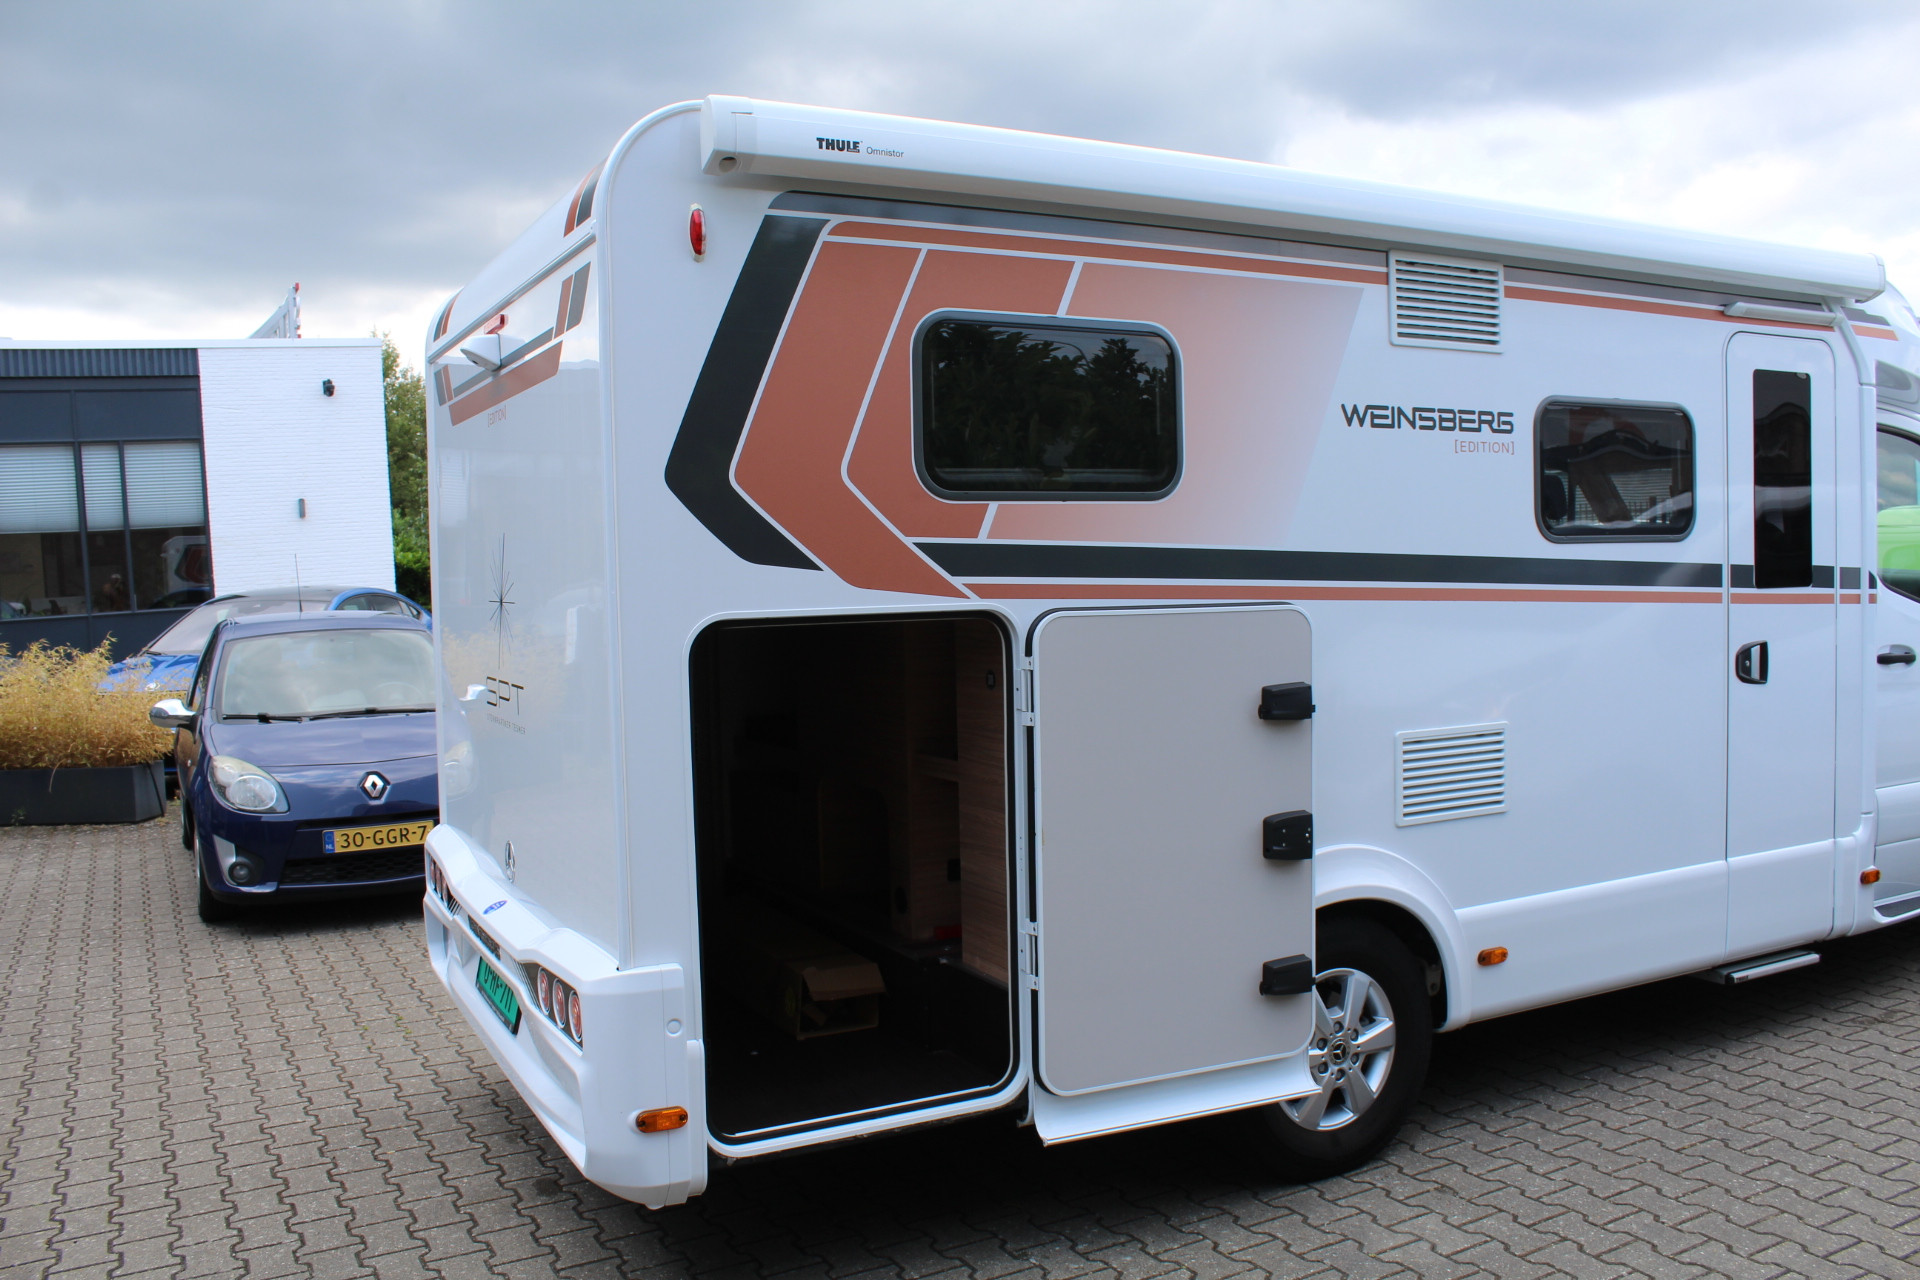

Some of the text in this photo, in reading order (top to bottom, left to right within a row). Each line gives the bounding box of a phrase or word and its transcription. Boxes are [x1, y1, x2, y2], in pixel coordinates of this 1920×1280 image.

[816, 136, 905, 158] THULE Omnistor
[1341, 403, 1514, 434] WEINSBERG
[1454, 439, 1515, 455] [EDITION]
[340, 825, 427, 849] 30-GGR-7
